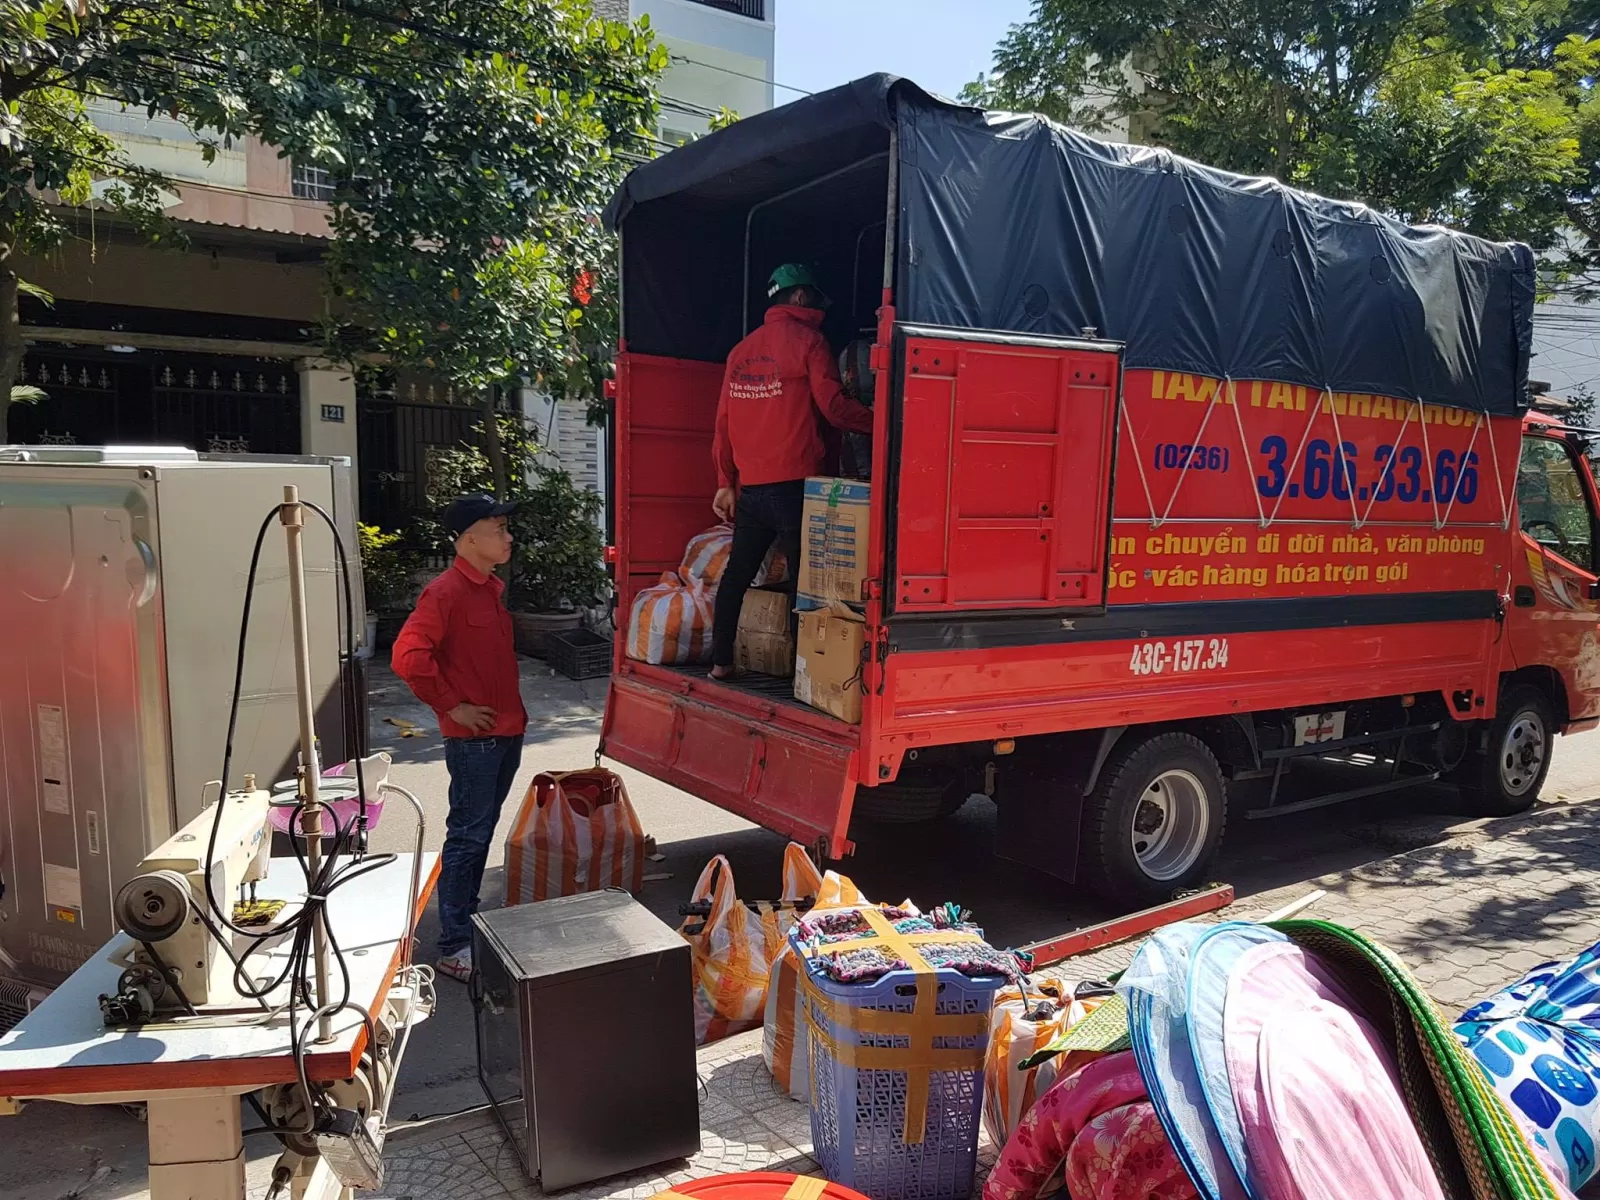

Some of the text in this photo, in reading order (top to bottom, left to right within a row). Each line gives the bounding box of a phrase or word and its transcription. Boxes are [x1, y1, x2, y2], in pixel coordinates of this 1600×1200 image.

[323, 406, 342, 419] 121
[1154, 435, 1479, 504] (0236) 3.66.33.66
[1146, 527, 1247, 556] chuyển
[1288, 534, 1325, 554] dời
[1332, 533, 1379, 555] nhà,
[1386, 534, 1422, 553] văn
[1426, 535, 1485, 555] phòng
[1151, 565, 1199, 587] vác
[1203, 564, 1268, 587] hàng
[1276, 563, 1320, 584] hóa
[1325, 563, 1369, 584] trọn
[1376, 561, 1409, 583] gói
[1129, 638, 1229, 675] 43C-157.34
